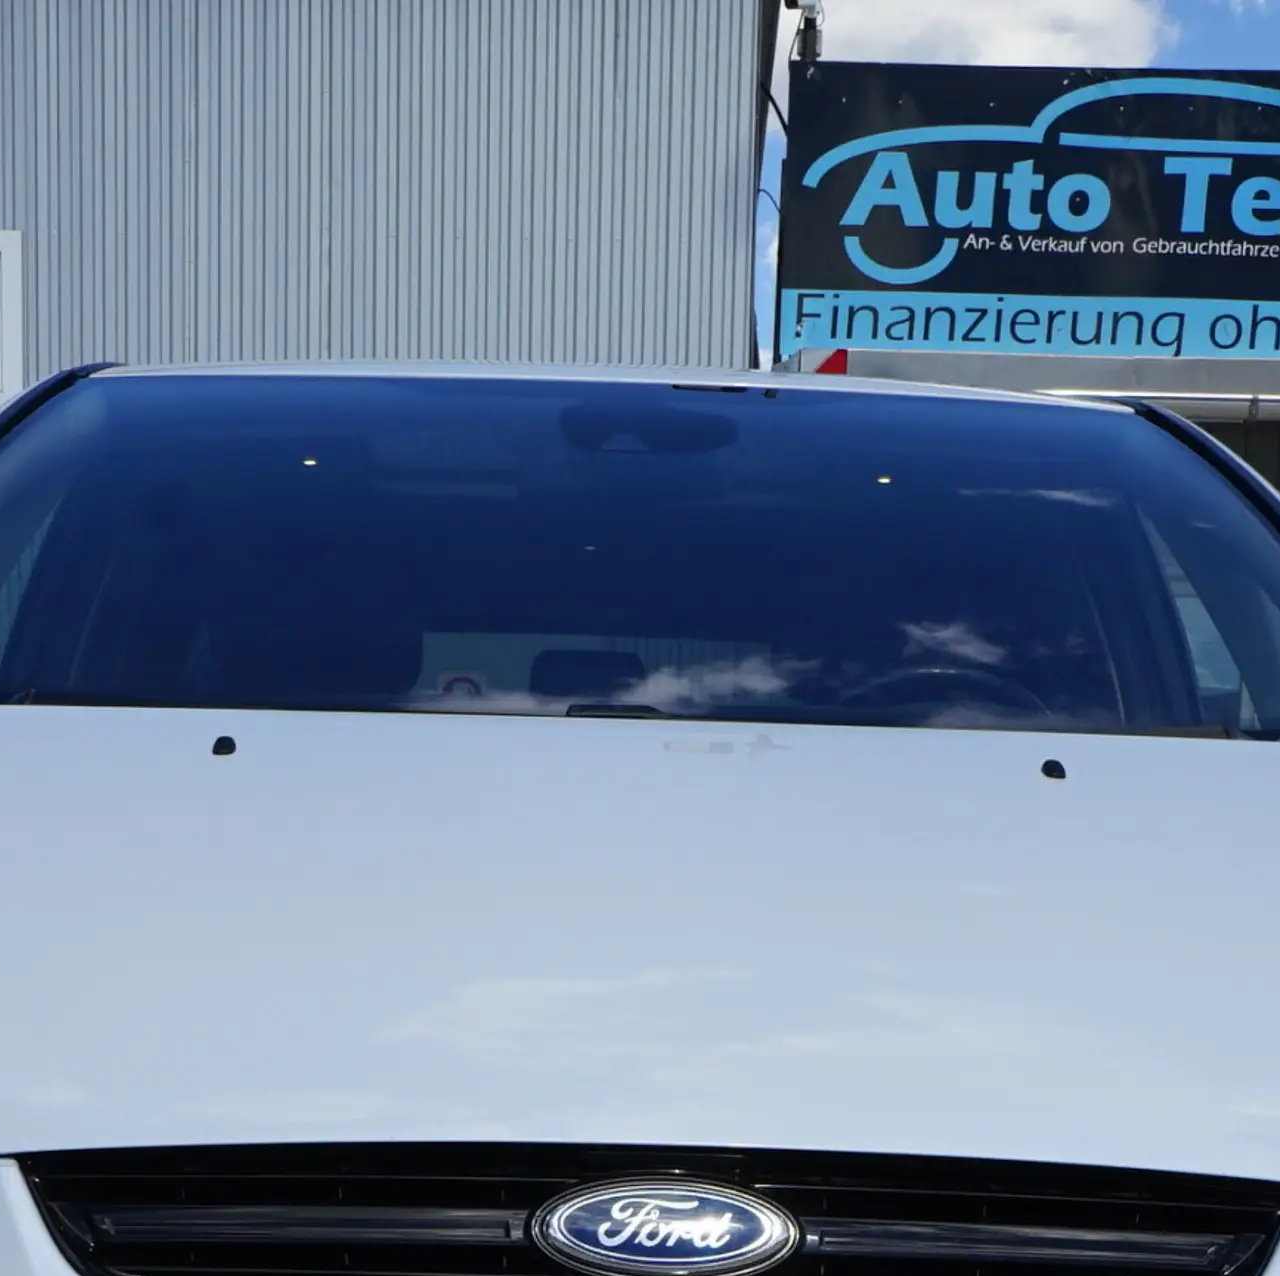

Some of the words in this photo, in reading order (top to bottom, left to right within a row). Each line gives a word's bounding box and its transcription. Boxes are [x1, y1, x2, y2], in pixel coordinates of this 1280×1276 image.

[839, 151, 1111, 233] Auto
[963, 233, 996, 250] An-
[999, 234, 1013, 251] &
[1018, 235, 1087, 253] Verkauf
[1090, 240, 1125, 254] von
[796, 293, 1186, 358] Finanzierung
[596, 1198, 736, 1249] Ford
